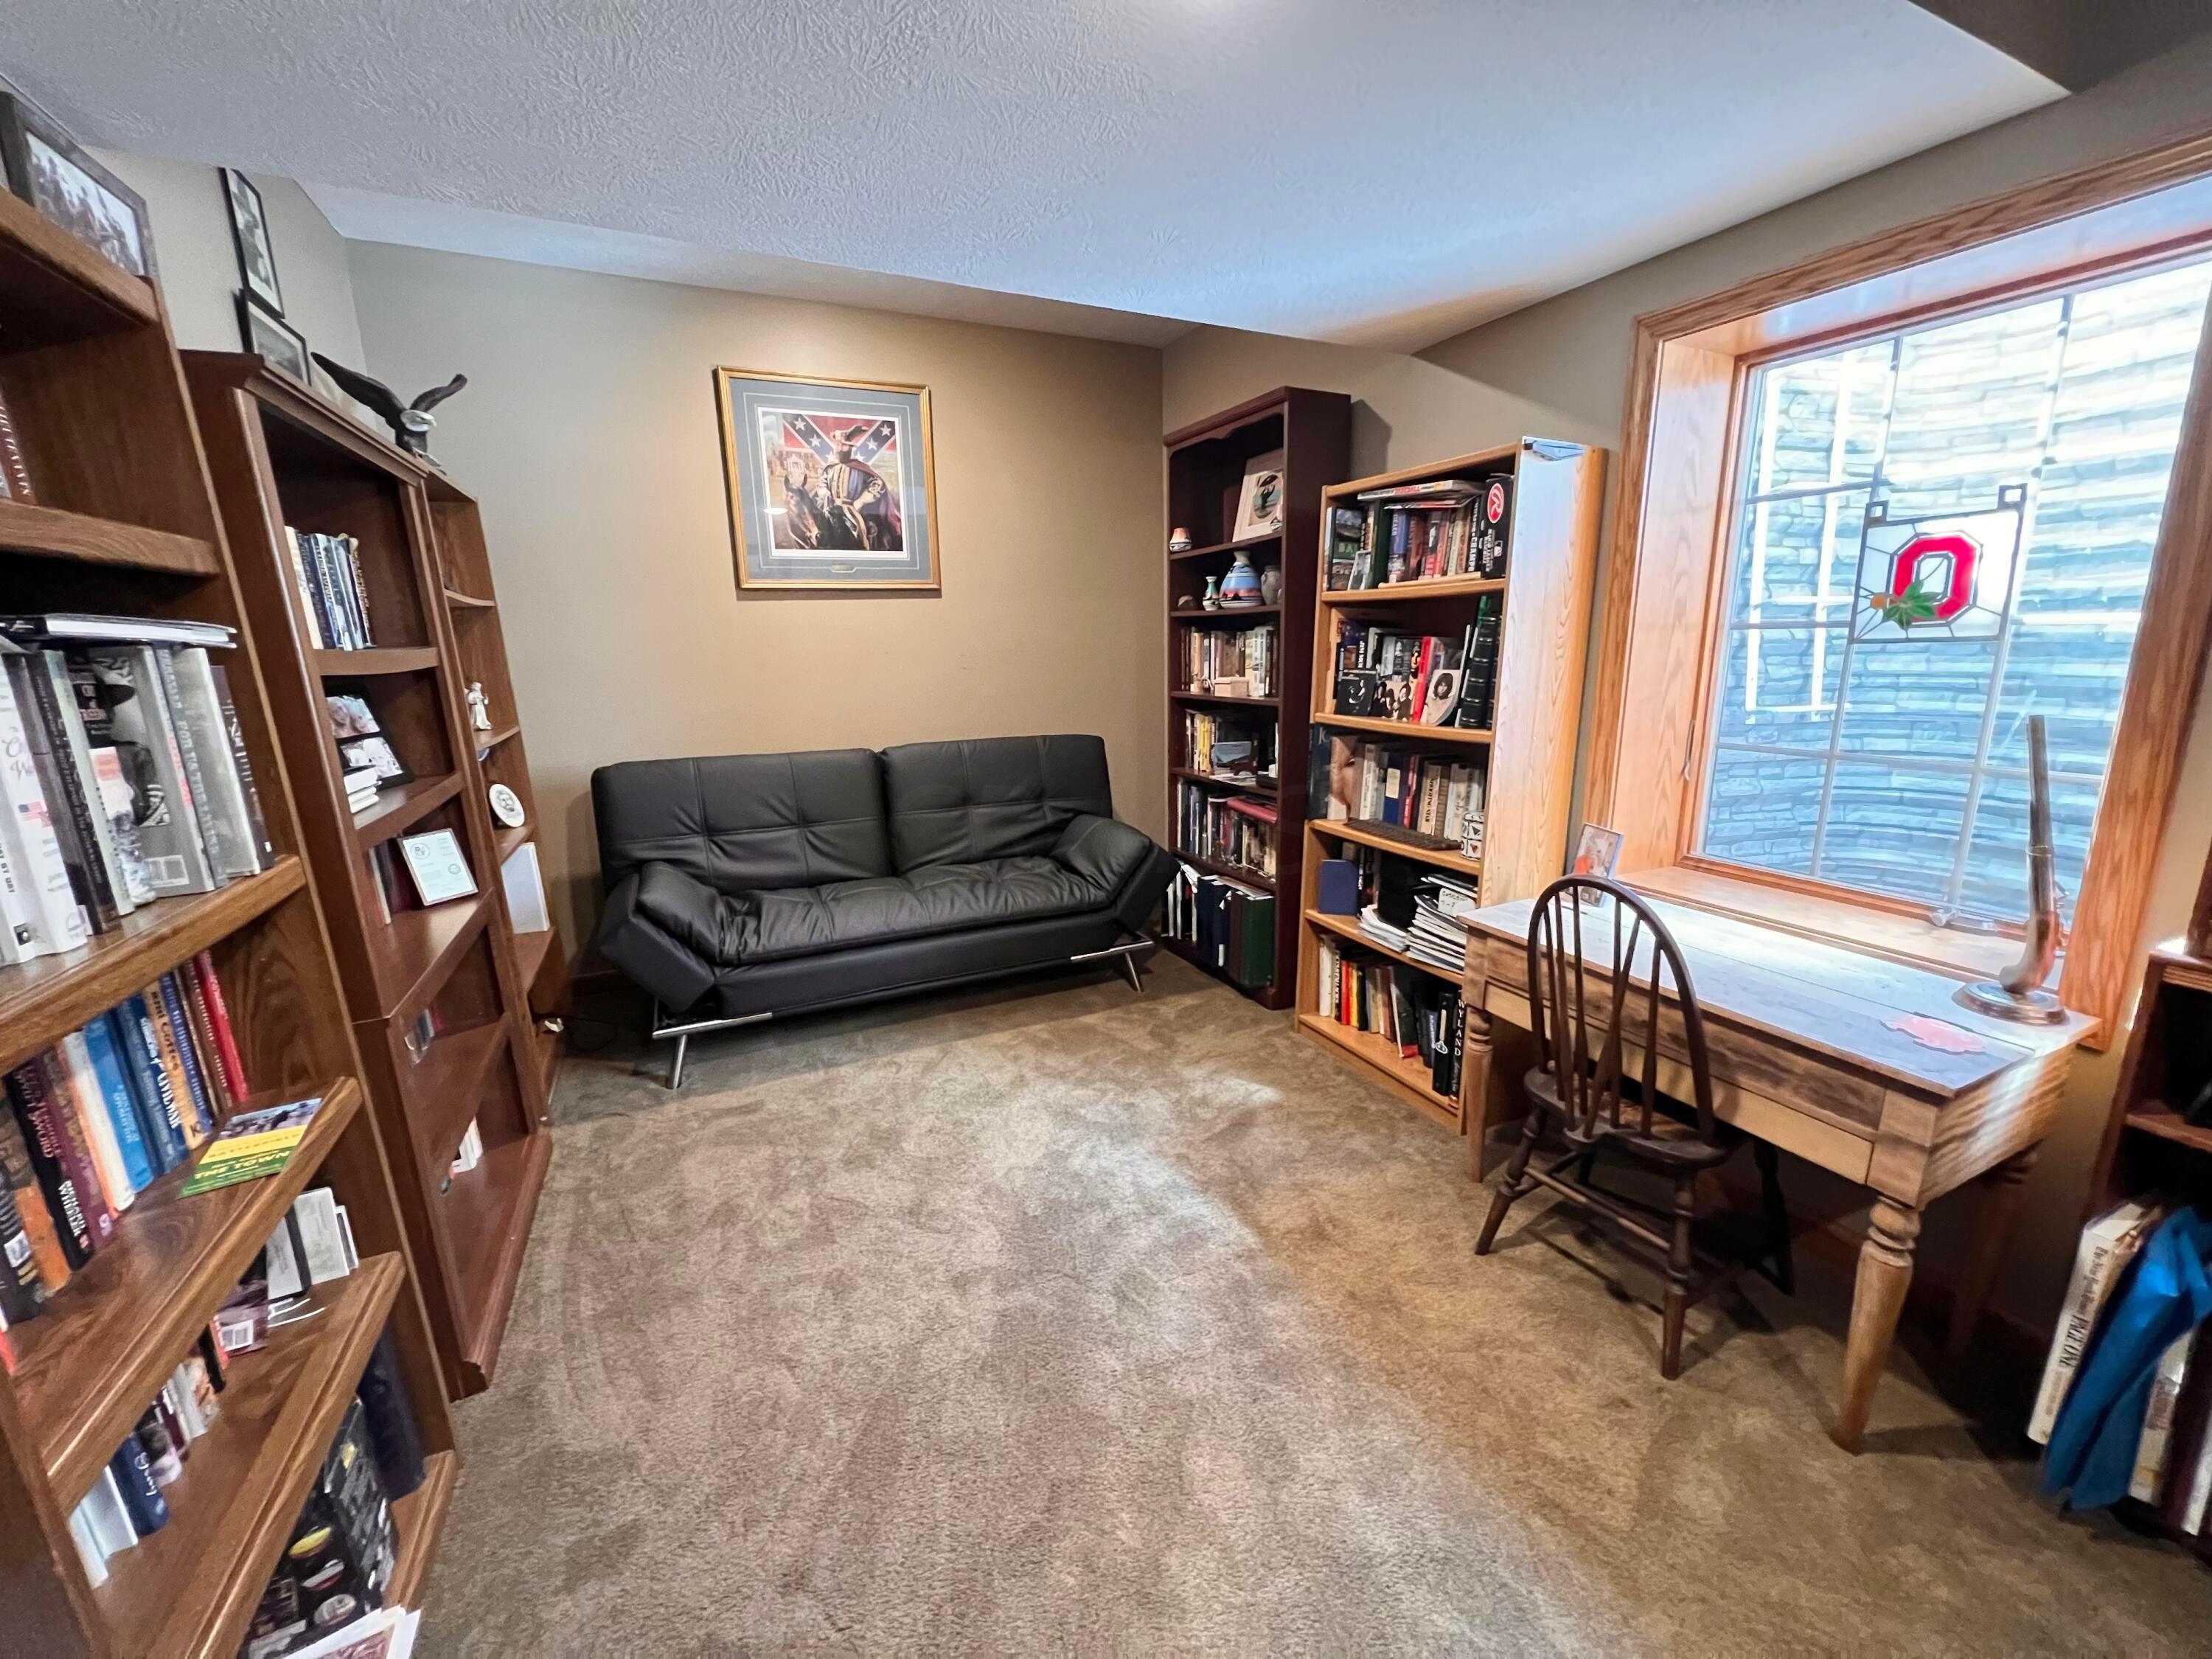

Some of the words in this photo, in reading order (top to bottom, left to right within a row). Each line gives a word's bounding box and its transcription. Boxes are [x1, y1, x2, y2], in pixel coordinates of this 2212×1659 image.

[1887, 530, 1983, 628] O
[1454, 998, 1467, 1057] WYLAND
[2065, 1315, 2090, 1346] PAGE
[2059, 1343, 2081, 1368] ONE
